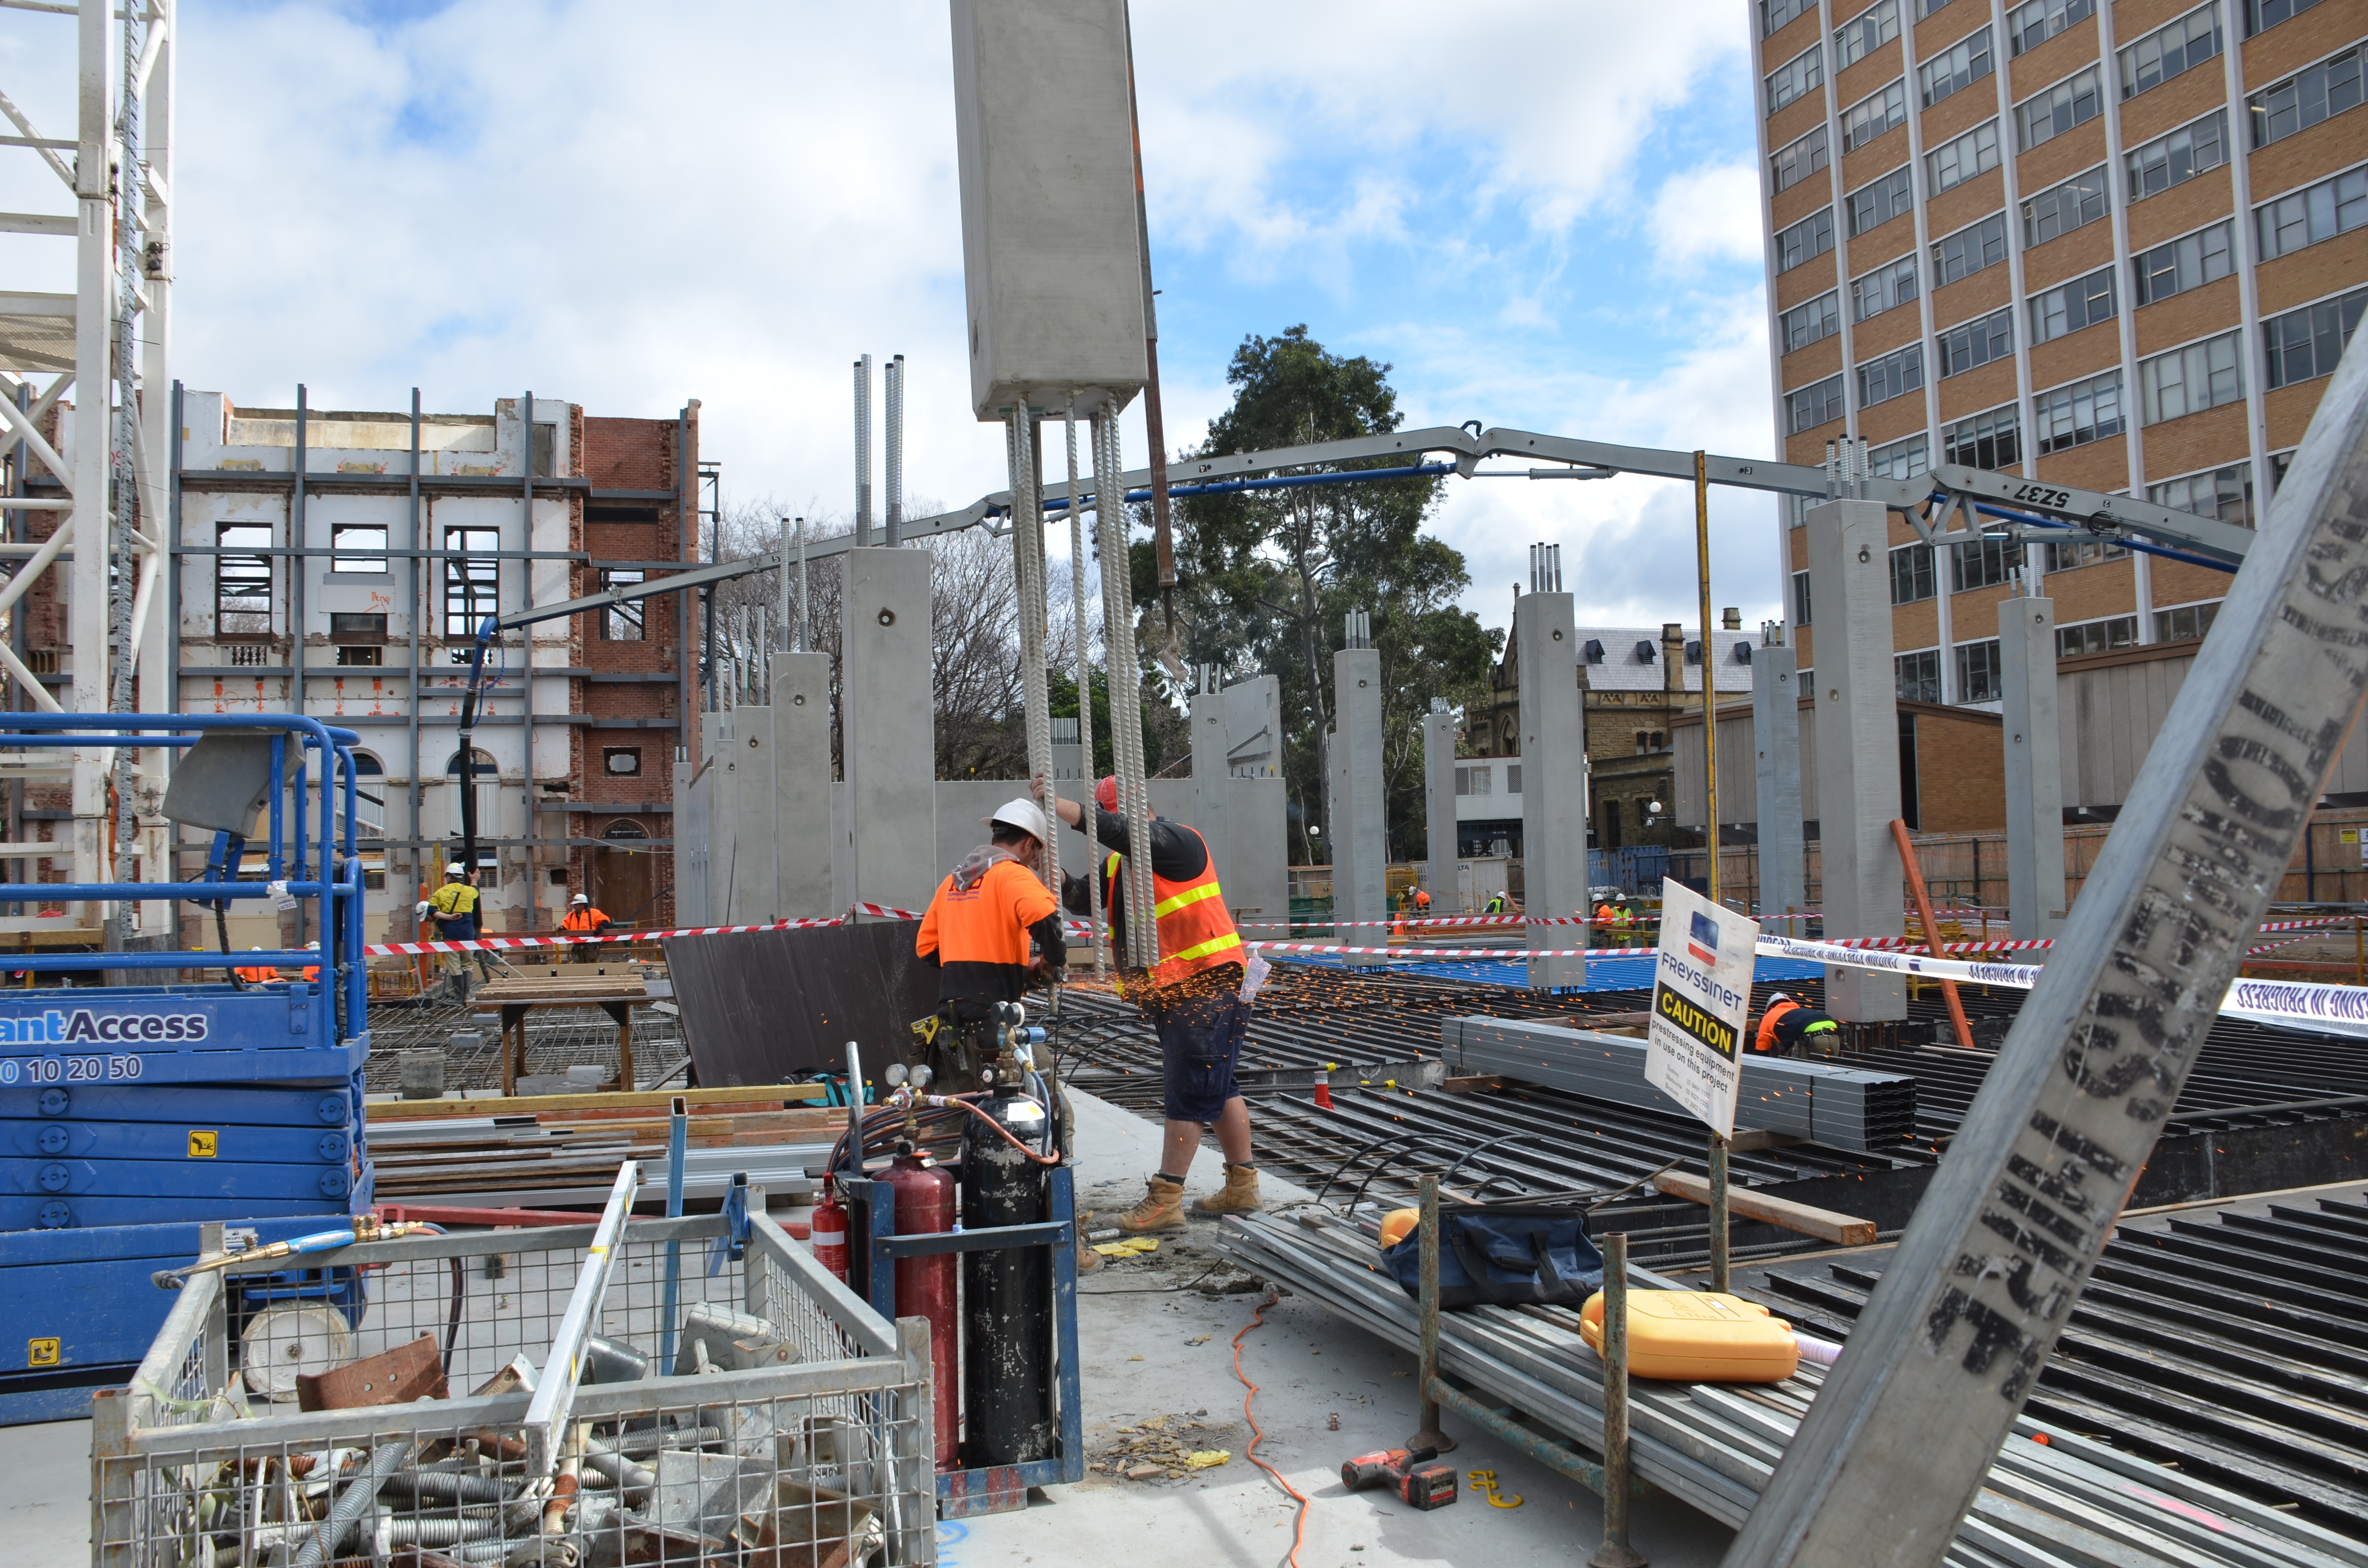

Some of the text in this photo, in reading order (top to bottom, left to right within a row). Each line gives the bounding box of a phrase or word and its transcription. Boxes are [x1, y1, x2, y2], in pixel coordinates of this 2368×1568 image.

[2013, 484, 2071, 508] 5Z37
[2054, 686, 2345, 1124] TOWERS
[1969, 962, 2020, 983] PROGRESS
[2237, 983, 2312, 1014] PROGRESS
[2310, 988, 2330, 1016] IN
[1662, 992, 1731, 1053] CAUTION
[1652, 1018, 1735, 1084] prestressing equipment
[1654, 1033, 1727, 1096] in use on this project
[27, 1058, 61, 1083] 10
[67, 1057, 103, 1081] 20
[109, 1055, 143, 1080] 50
[1665, 1073, 1682, 1090] Melbourne
[1666, 1064, 1679, 1078] Sydney
[1665, 1082, 1678, 1097] Brisbane
[1928, 1110, 2135, 1401] HIRE
